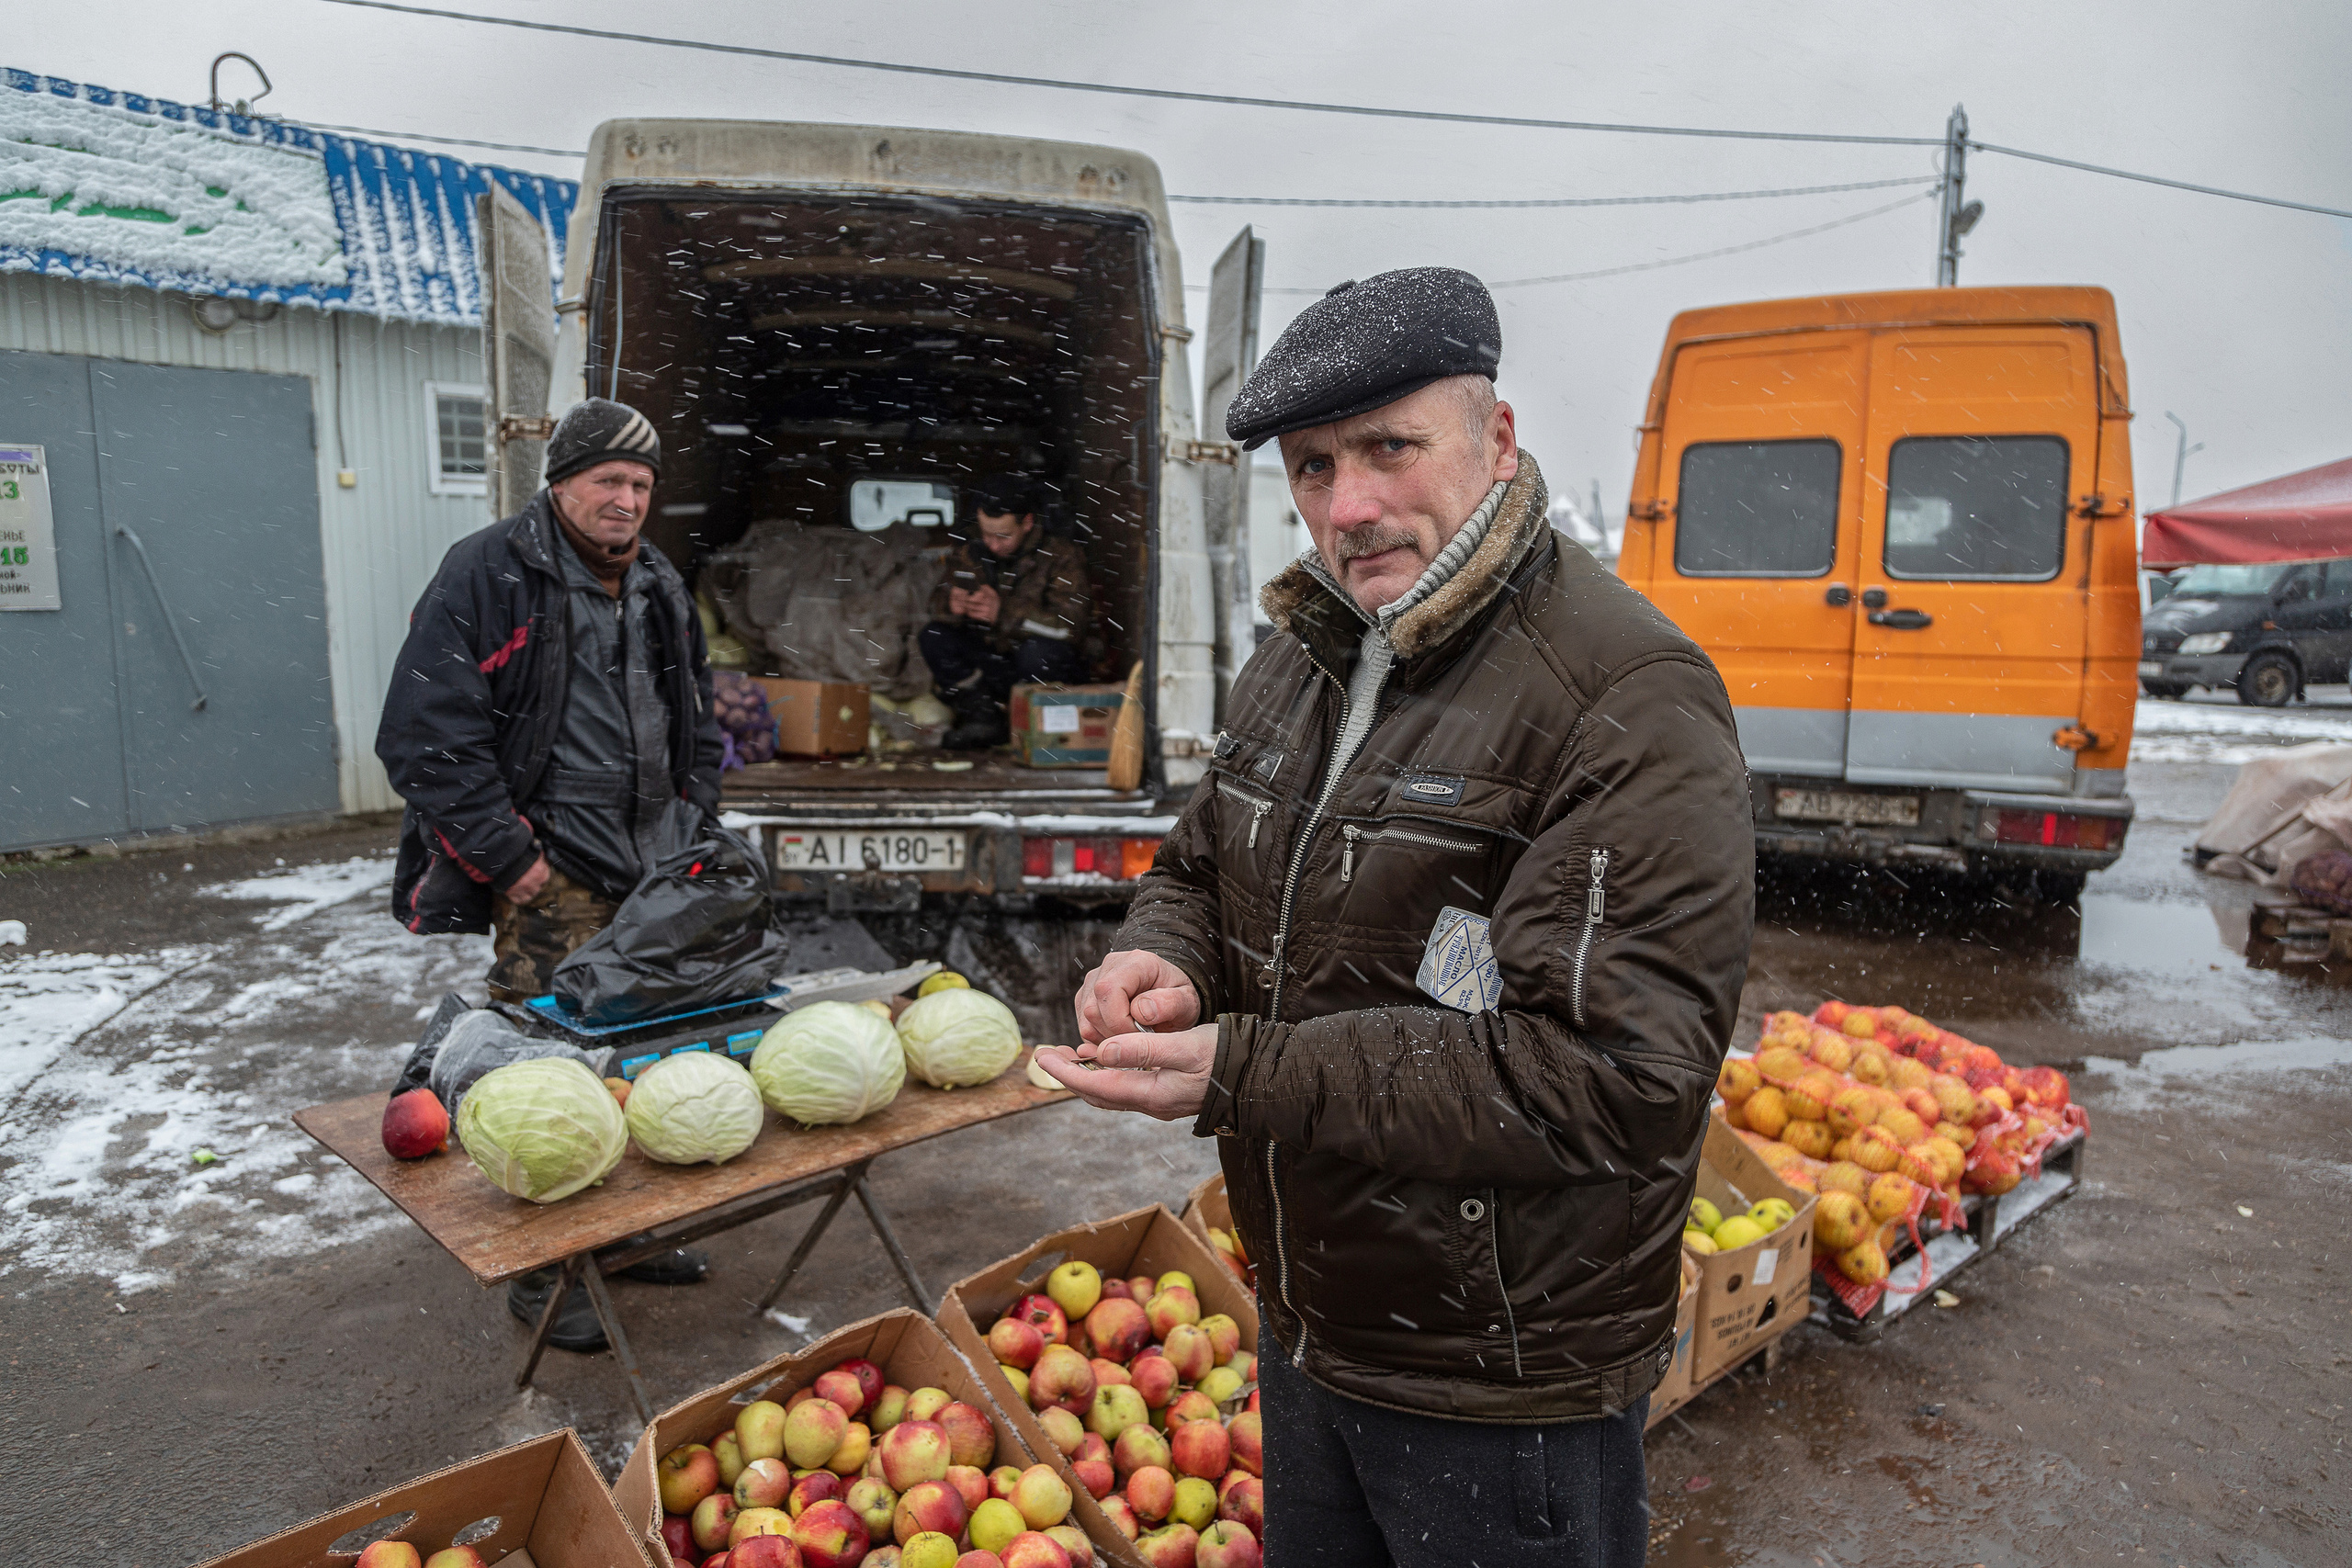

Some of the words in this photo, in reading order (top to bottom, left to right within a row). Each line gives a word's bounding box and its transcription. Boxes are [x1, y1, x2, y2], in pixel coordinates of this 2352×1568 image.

[0, 479, 19, 500] 3
[1451, 946, 1468, 980] МАСЛО
[1486, 963, 1496, 978] 500
